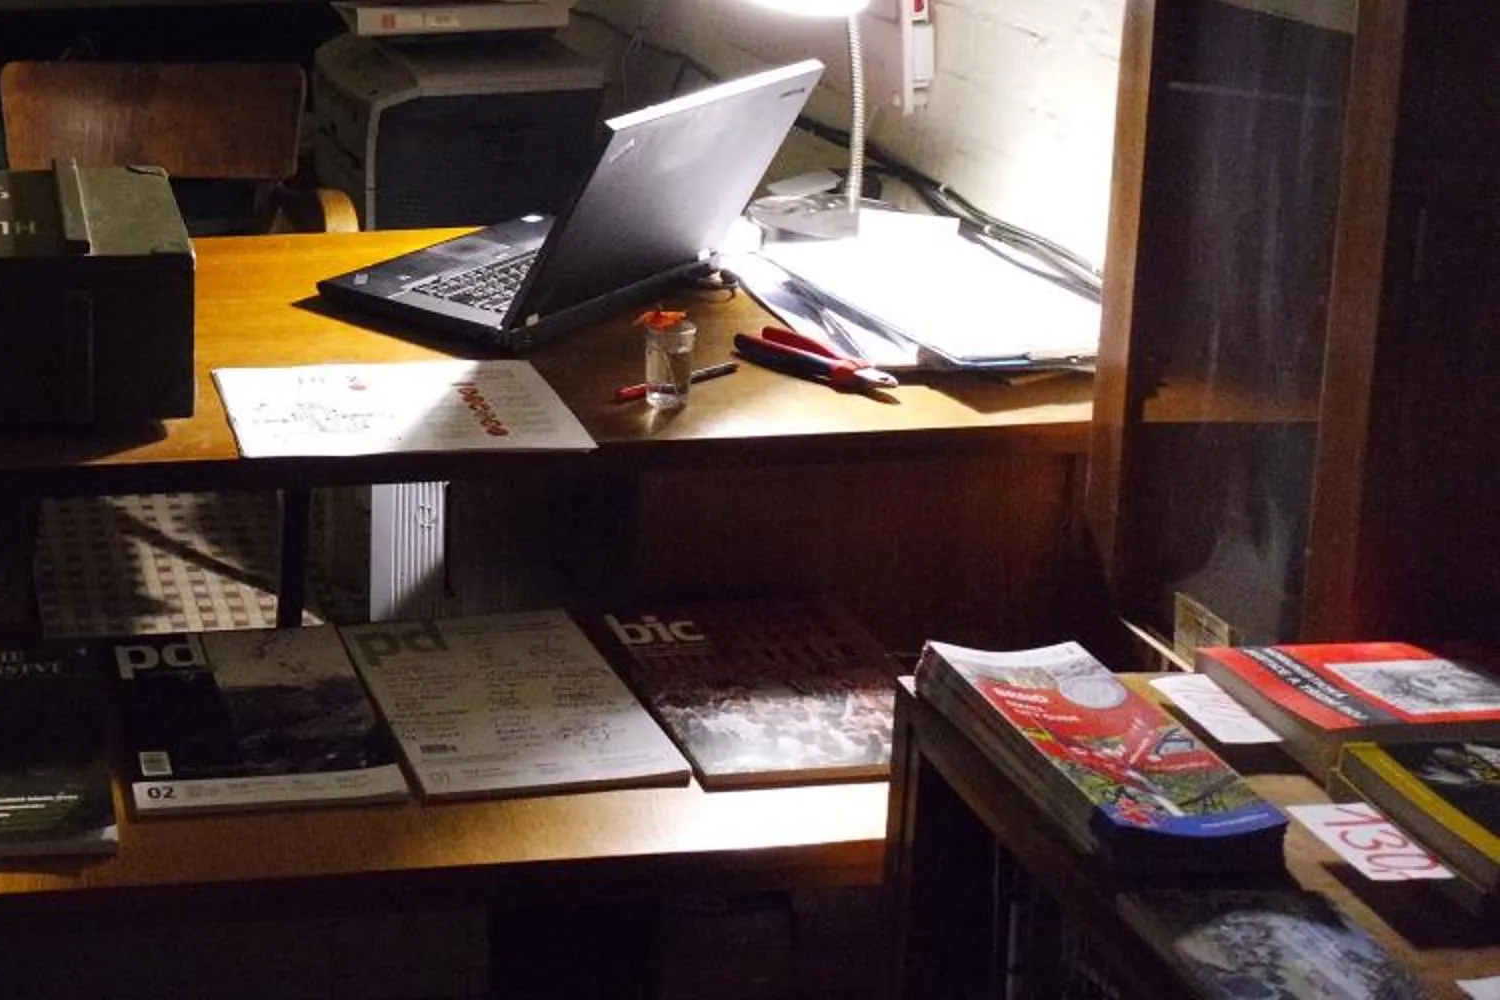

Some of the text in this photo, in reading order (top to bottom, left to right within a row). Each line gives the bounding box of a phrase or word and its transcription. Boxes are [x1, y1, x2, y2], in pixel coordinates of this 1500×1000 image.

[353, 621, 449, 667] pd
[603, 613, 705, 645] bic
[114, 634, 208, 680] pd
[147, 787, 176, 799] 02
